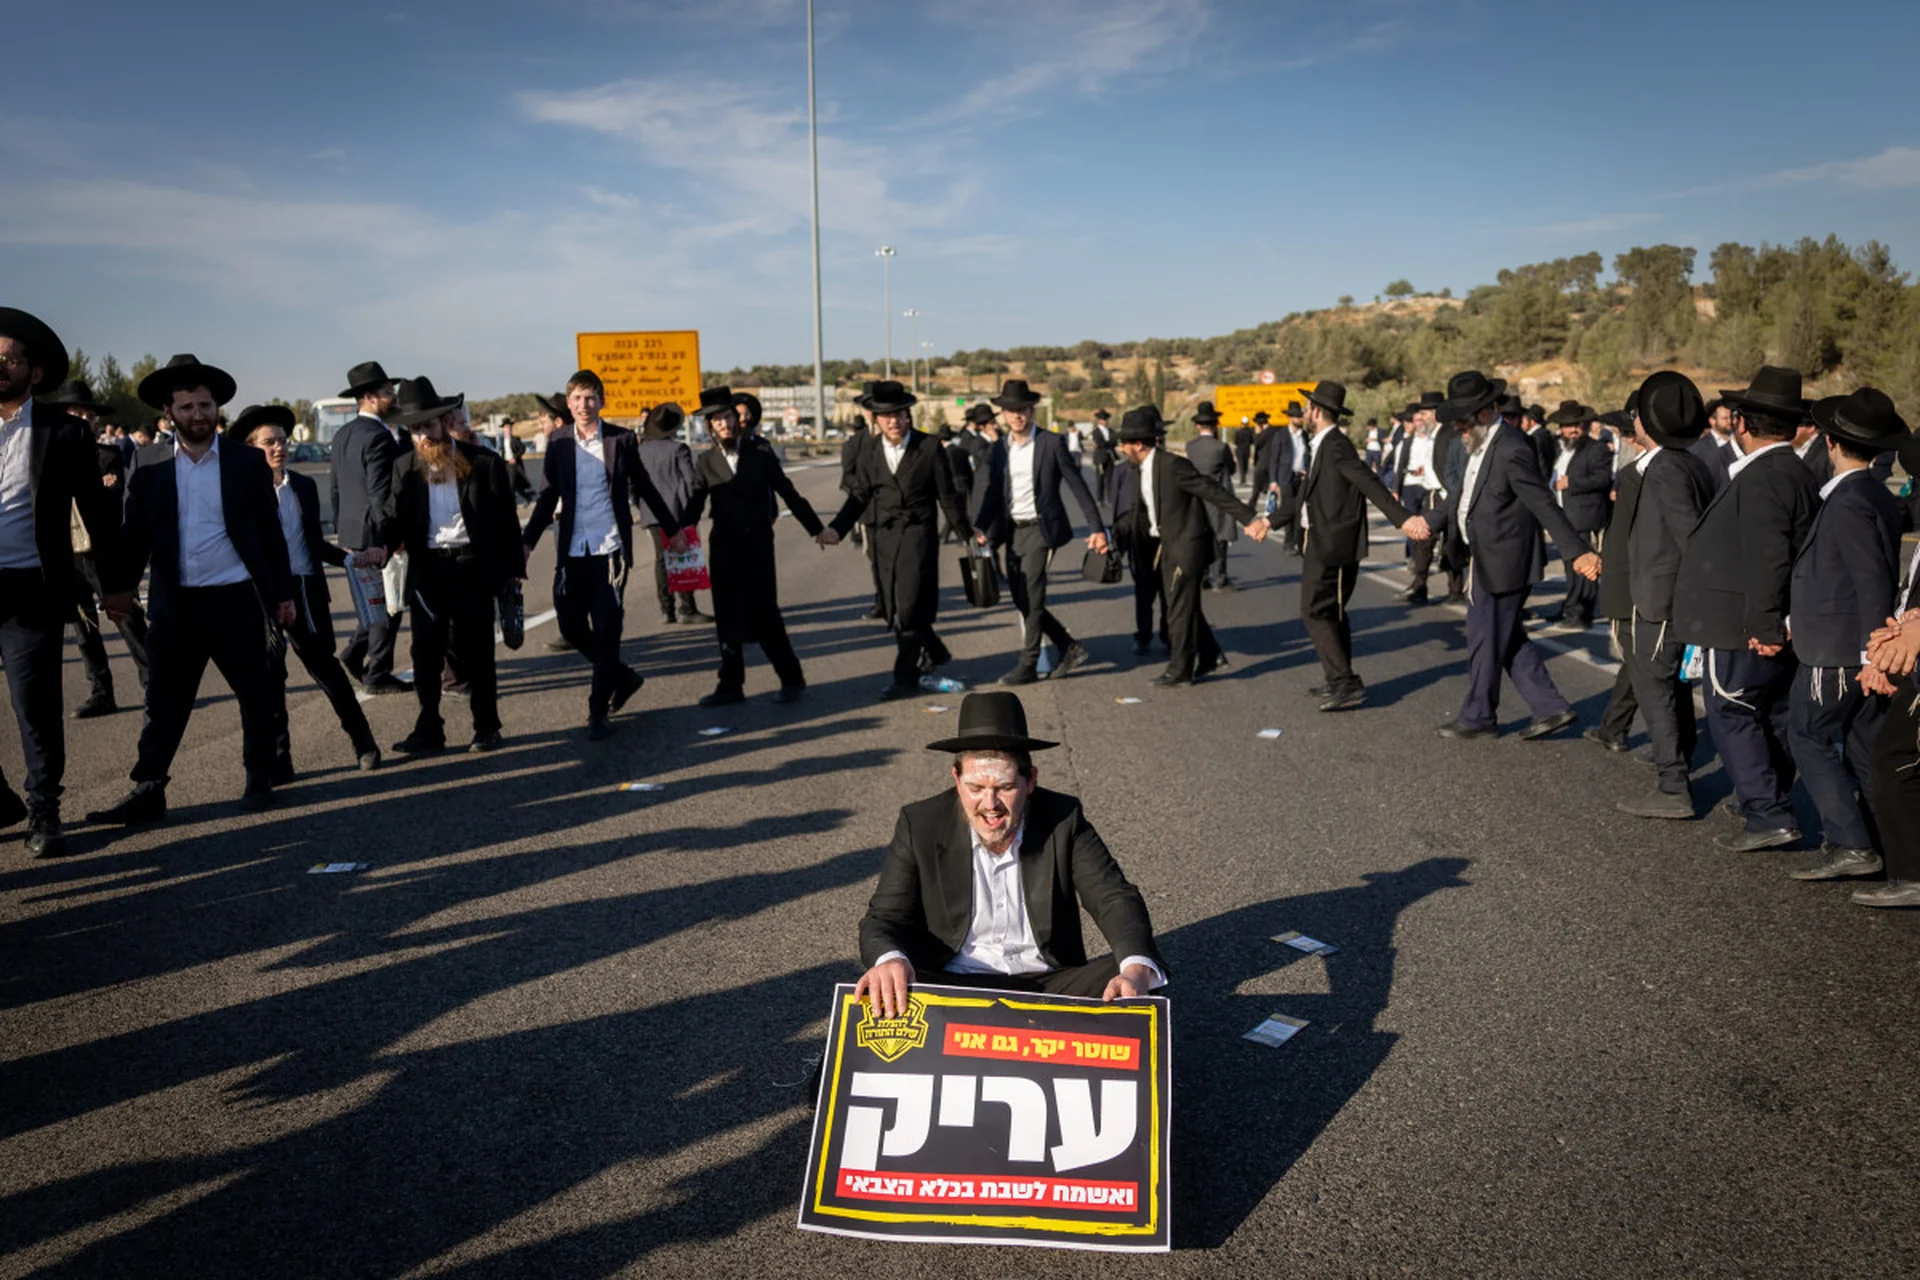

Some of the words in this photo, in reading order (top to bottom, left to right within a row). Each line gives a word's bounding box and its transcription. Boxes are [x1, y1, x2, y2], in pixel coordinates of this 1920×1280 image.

[644, 338, 662, 349] רכב
[630, 387, 684, 397] VEHICLES
[865, 1028, 895, 1039] התורה
[953, 1031, 987, 1049] אני
[991, 1035, 1019, 1053] גם
[1023, 1037, 1065, 1059] יקר,
[1071, 1040, 1130, 1061] שוטר
[840, 1072, 1137, 1172] עריק
[845, 1174, 914, 1196] הצבאי
[919, 1176, 975, 1199] בכלא
[979, 1178, 1047, 1202] לשבת
[1052, 1184, 1134, 1206] ואשמח
